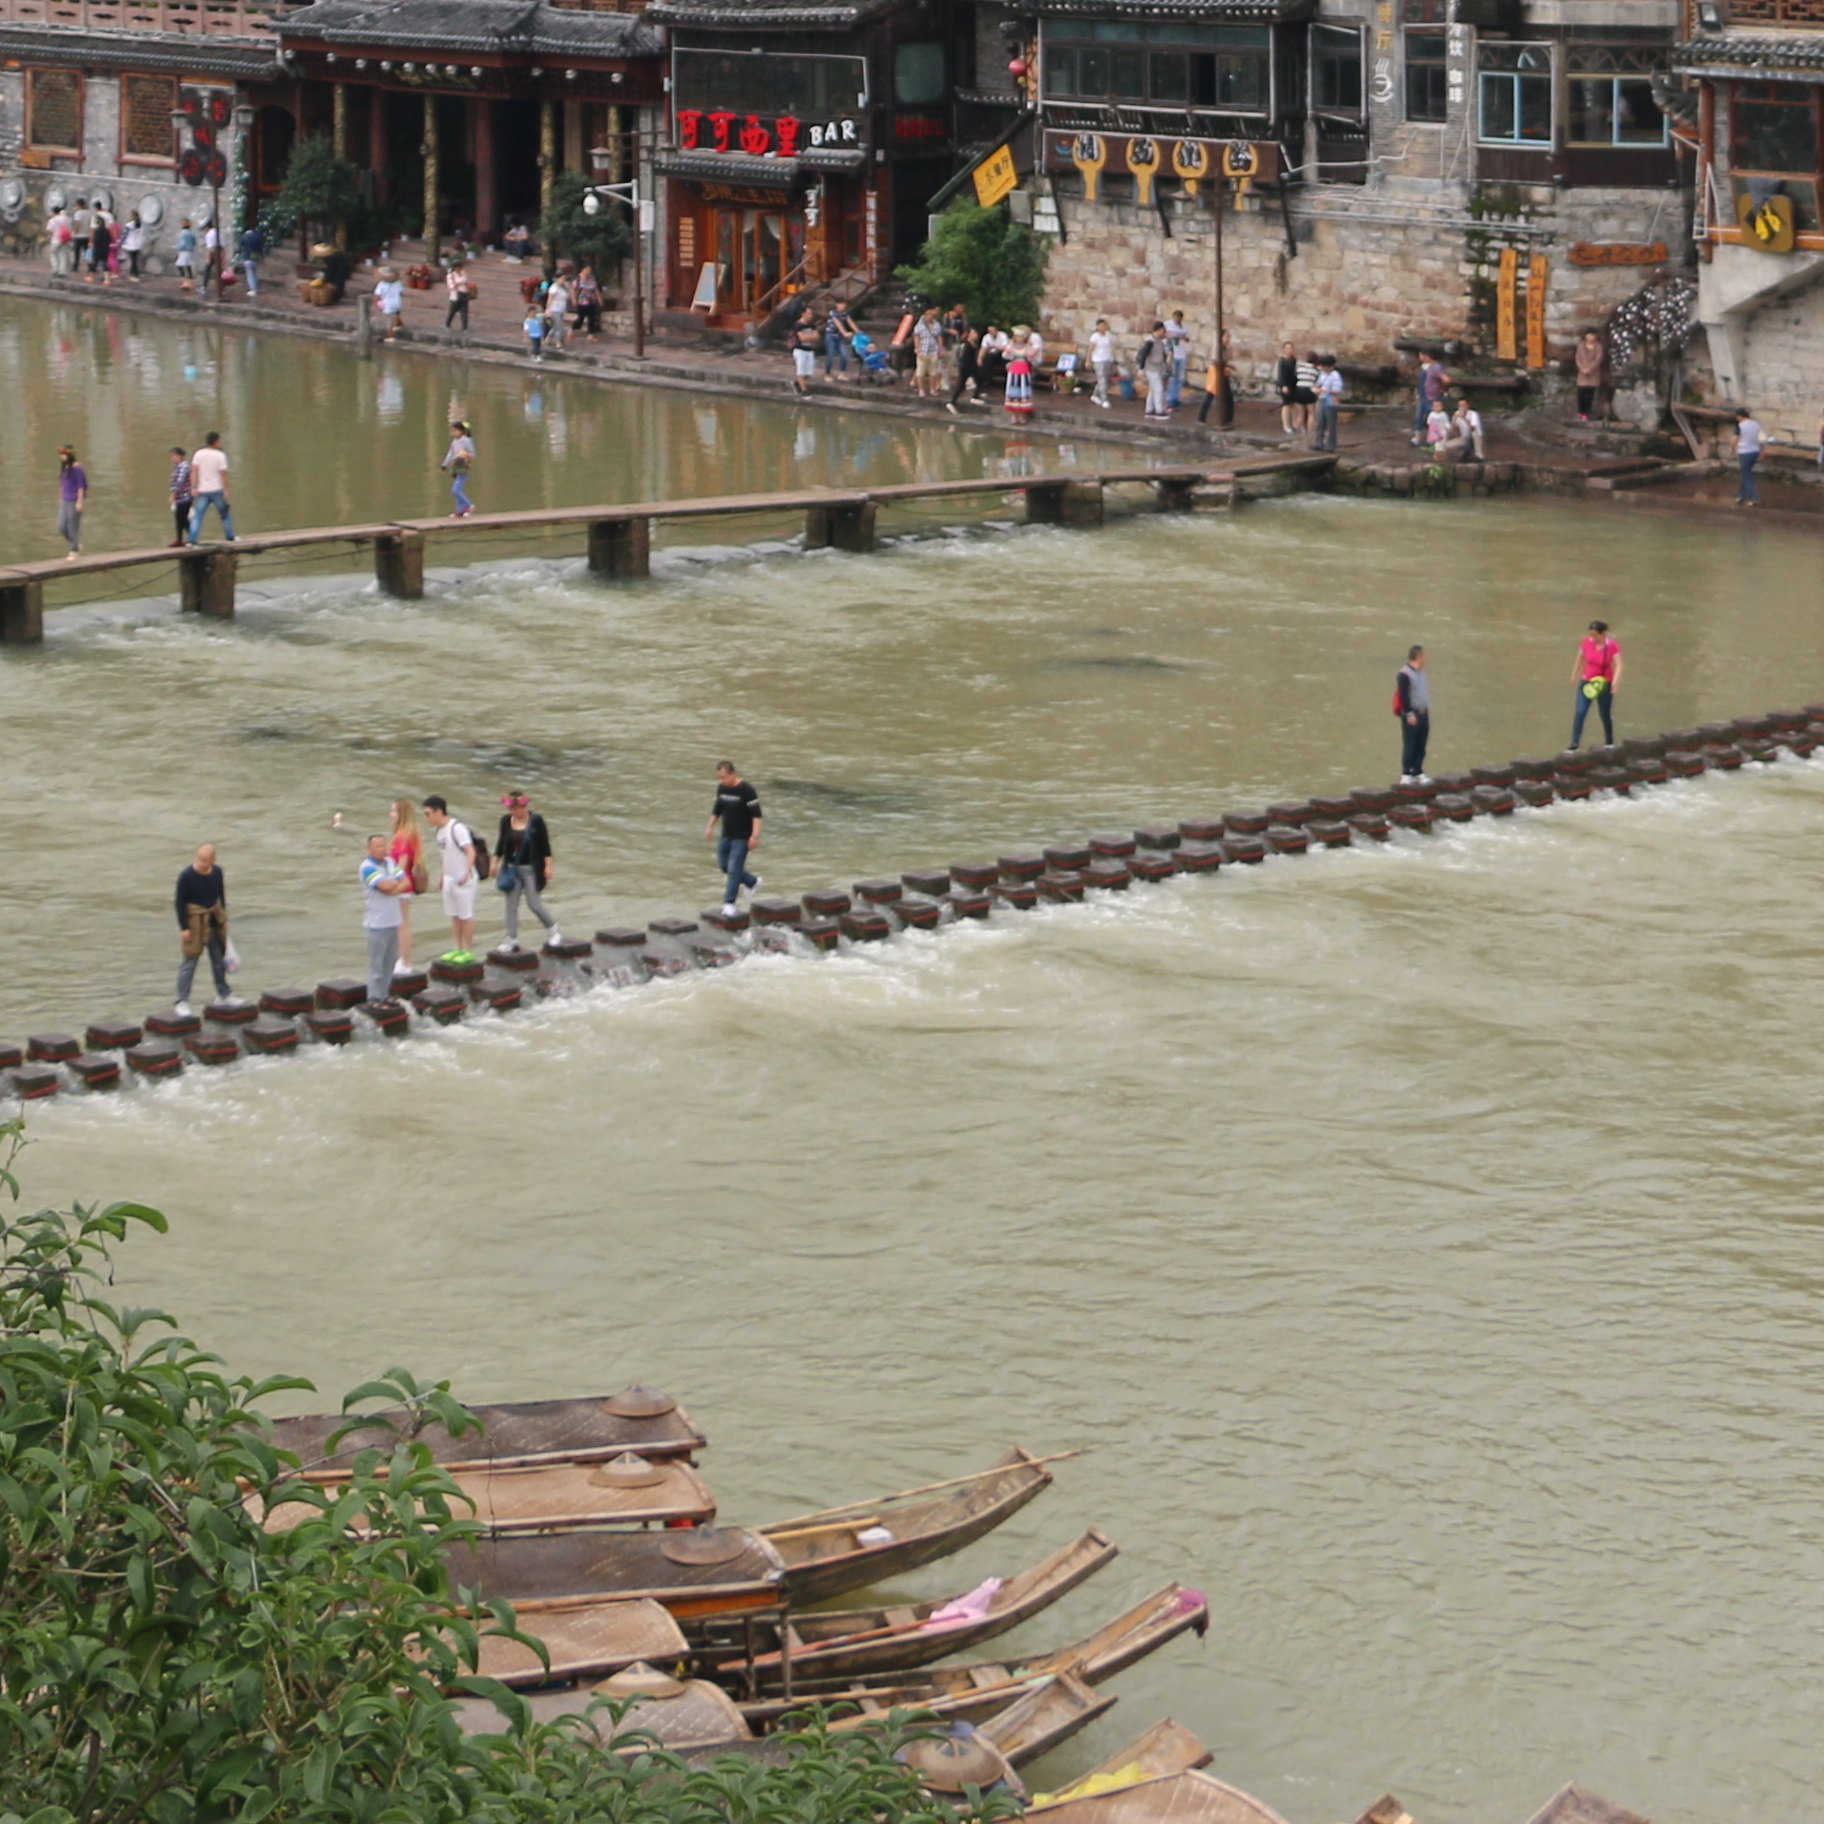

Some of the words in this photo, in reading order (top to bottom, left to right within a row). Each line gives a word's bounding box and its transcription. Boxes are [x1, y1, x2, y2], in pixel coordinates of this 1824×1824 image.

[676, 109, 801, 157] 可可西里
[809, 118, 857, 147] BAR
